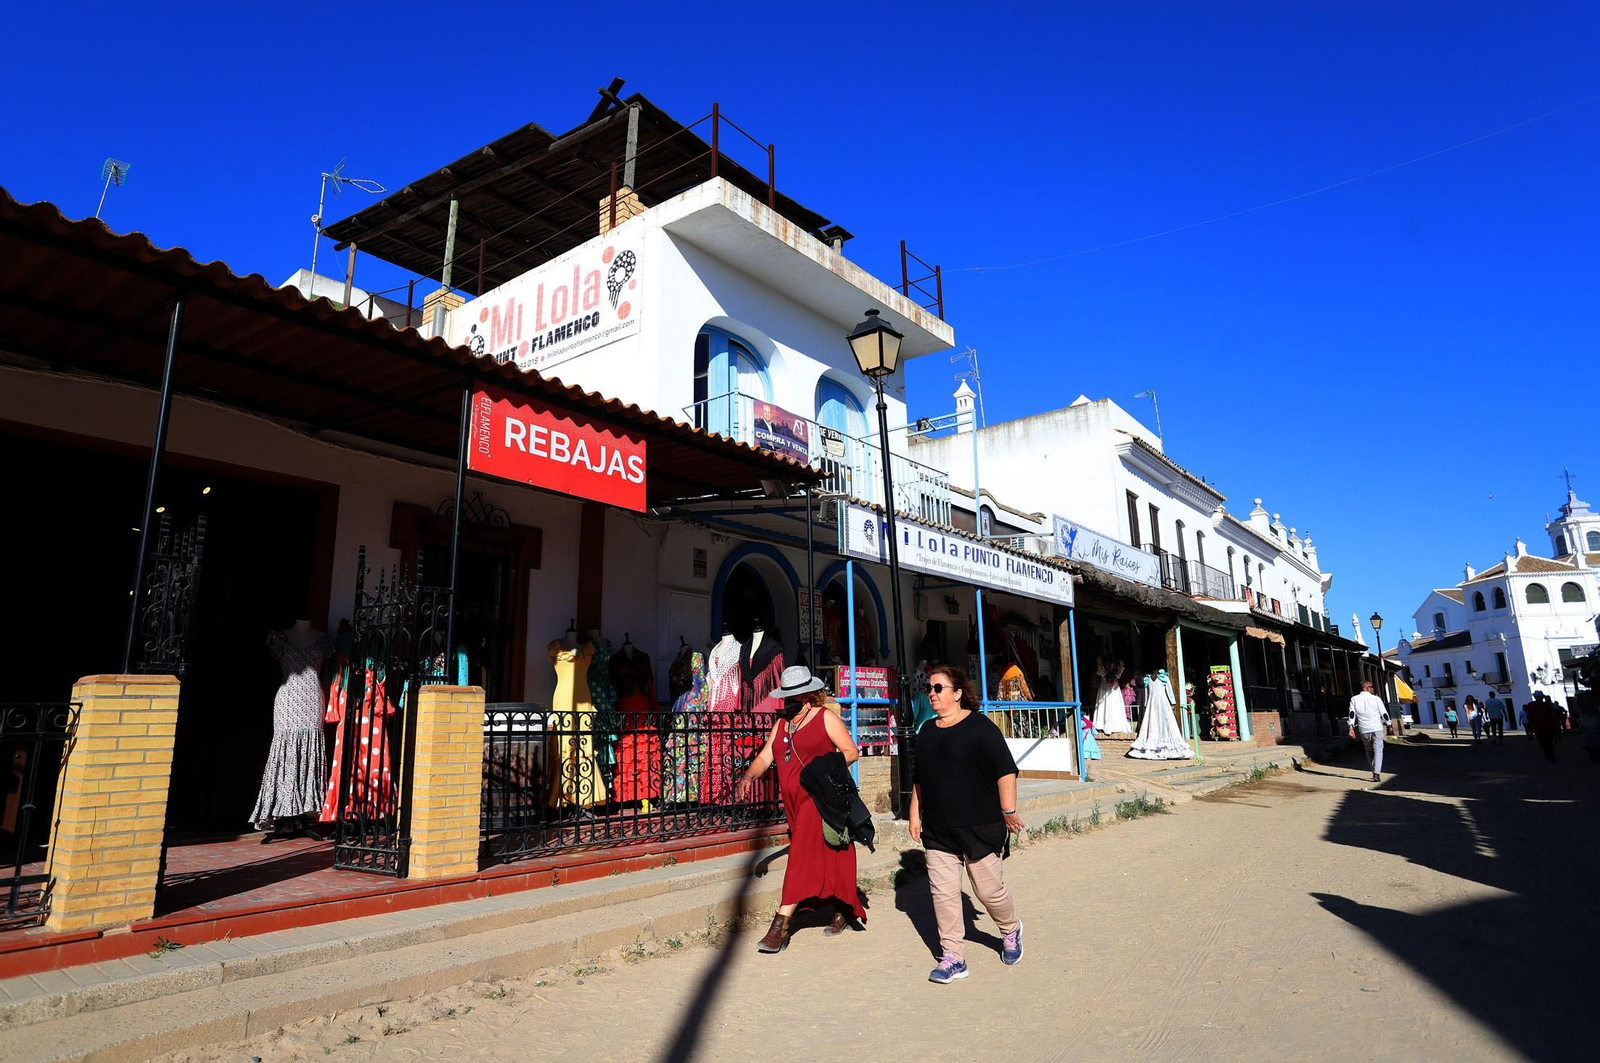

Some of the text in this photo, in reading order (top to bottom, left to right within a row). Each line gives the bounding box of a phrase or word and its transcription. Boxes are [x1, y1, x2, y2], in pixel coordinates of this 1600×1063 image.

[535, 264, 600, 332] Lola
[531, 311, 600, 353] FLAMENCO
[505, 416, 645, 484] REBAJAS
[756, 431, 785, 445] COMPRA
[792, 444, 808, 456] VENTA
[819, 428, 827, 437] SE
[917, 530, 959, 558] Lola
[964, 545, 1000, 568] PUNTO
[1006, 558, 1054, 584] FLAMENCO
[1091, 539, 1110, 565] Mis
